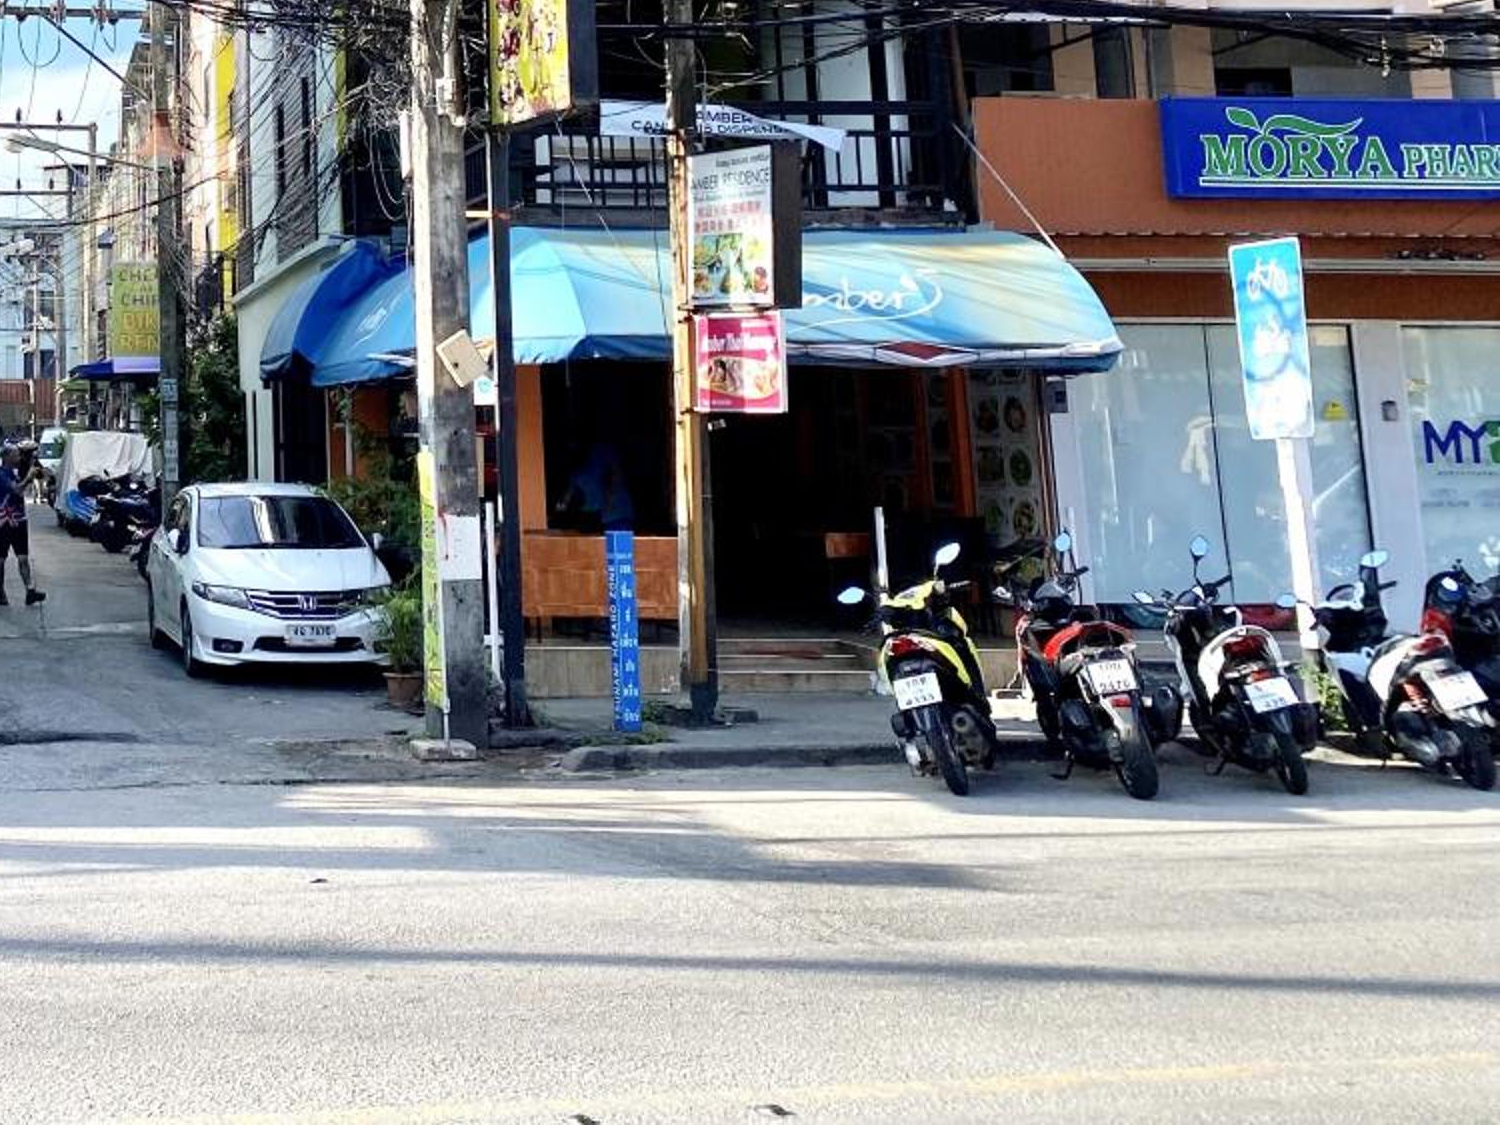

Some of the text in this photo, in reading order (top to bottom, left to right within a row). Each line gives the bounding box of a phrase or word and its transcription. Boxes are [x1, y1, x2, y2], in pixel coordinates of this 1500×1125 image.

[1201, 132, 1398, 179] MORYA
[1400, 143, 1500, 179] PHAR
[802, 275, 917, 311] mber
